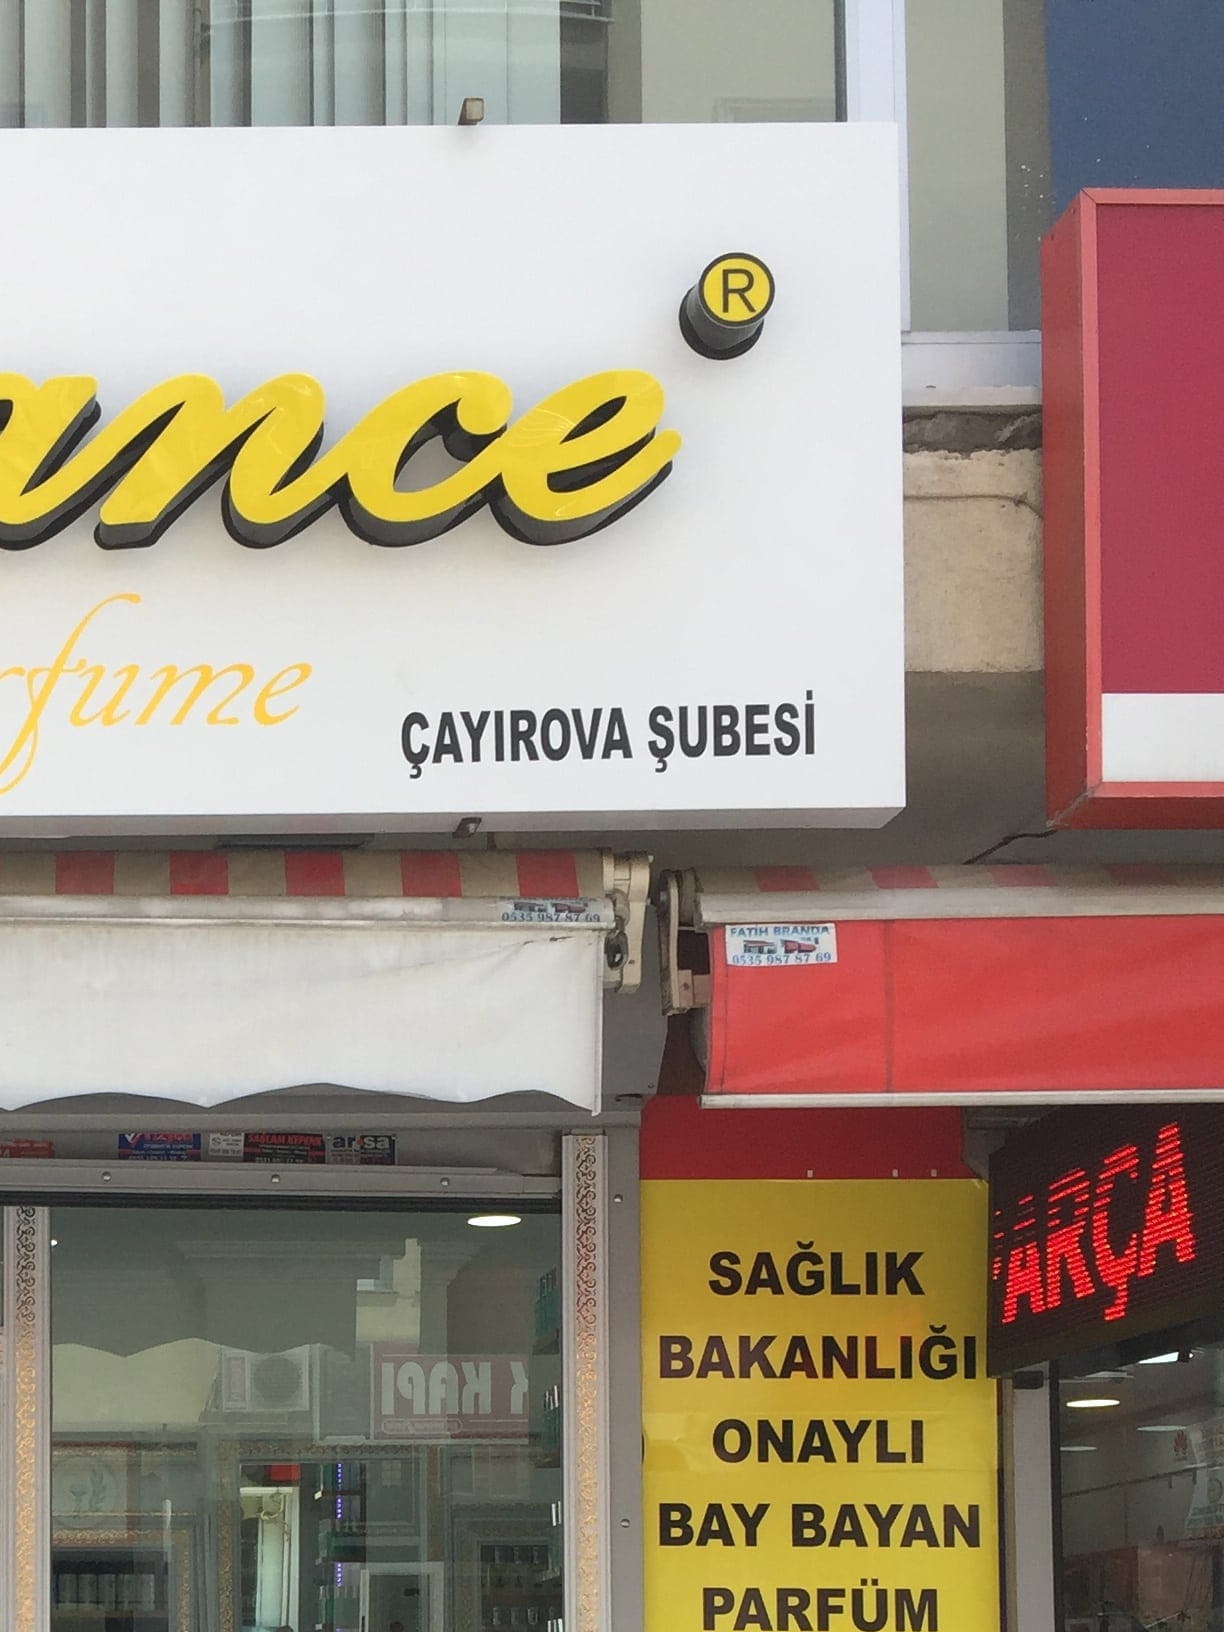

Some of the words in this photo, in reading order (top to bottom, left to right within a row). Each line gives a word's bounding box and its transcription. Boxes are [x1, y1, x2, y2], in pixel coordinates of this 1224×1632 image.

[400, 706, 633, 779] ÇAYIROVA
[646, 689, 817, 772] ŞUBESİ
[773, 924, 831, 936] BRANDA
[732, 954, 763, 966] 0535
[766, 953, 790, 965] 987
[794, 953, 811, 964] 87
[814, 950, 832, 963] 69
[708, 1240, 926, 1296] SAĞLIK
[658, 1324, 977, 1381] BAKANLIĞI
[712, 1419, 925, 1464] ONAYLI
[658, 1503, 771, 1547] BAY
[791, 1503, 982, 1549] BAYAN
